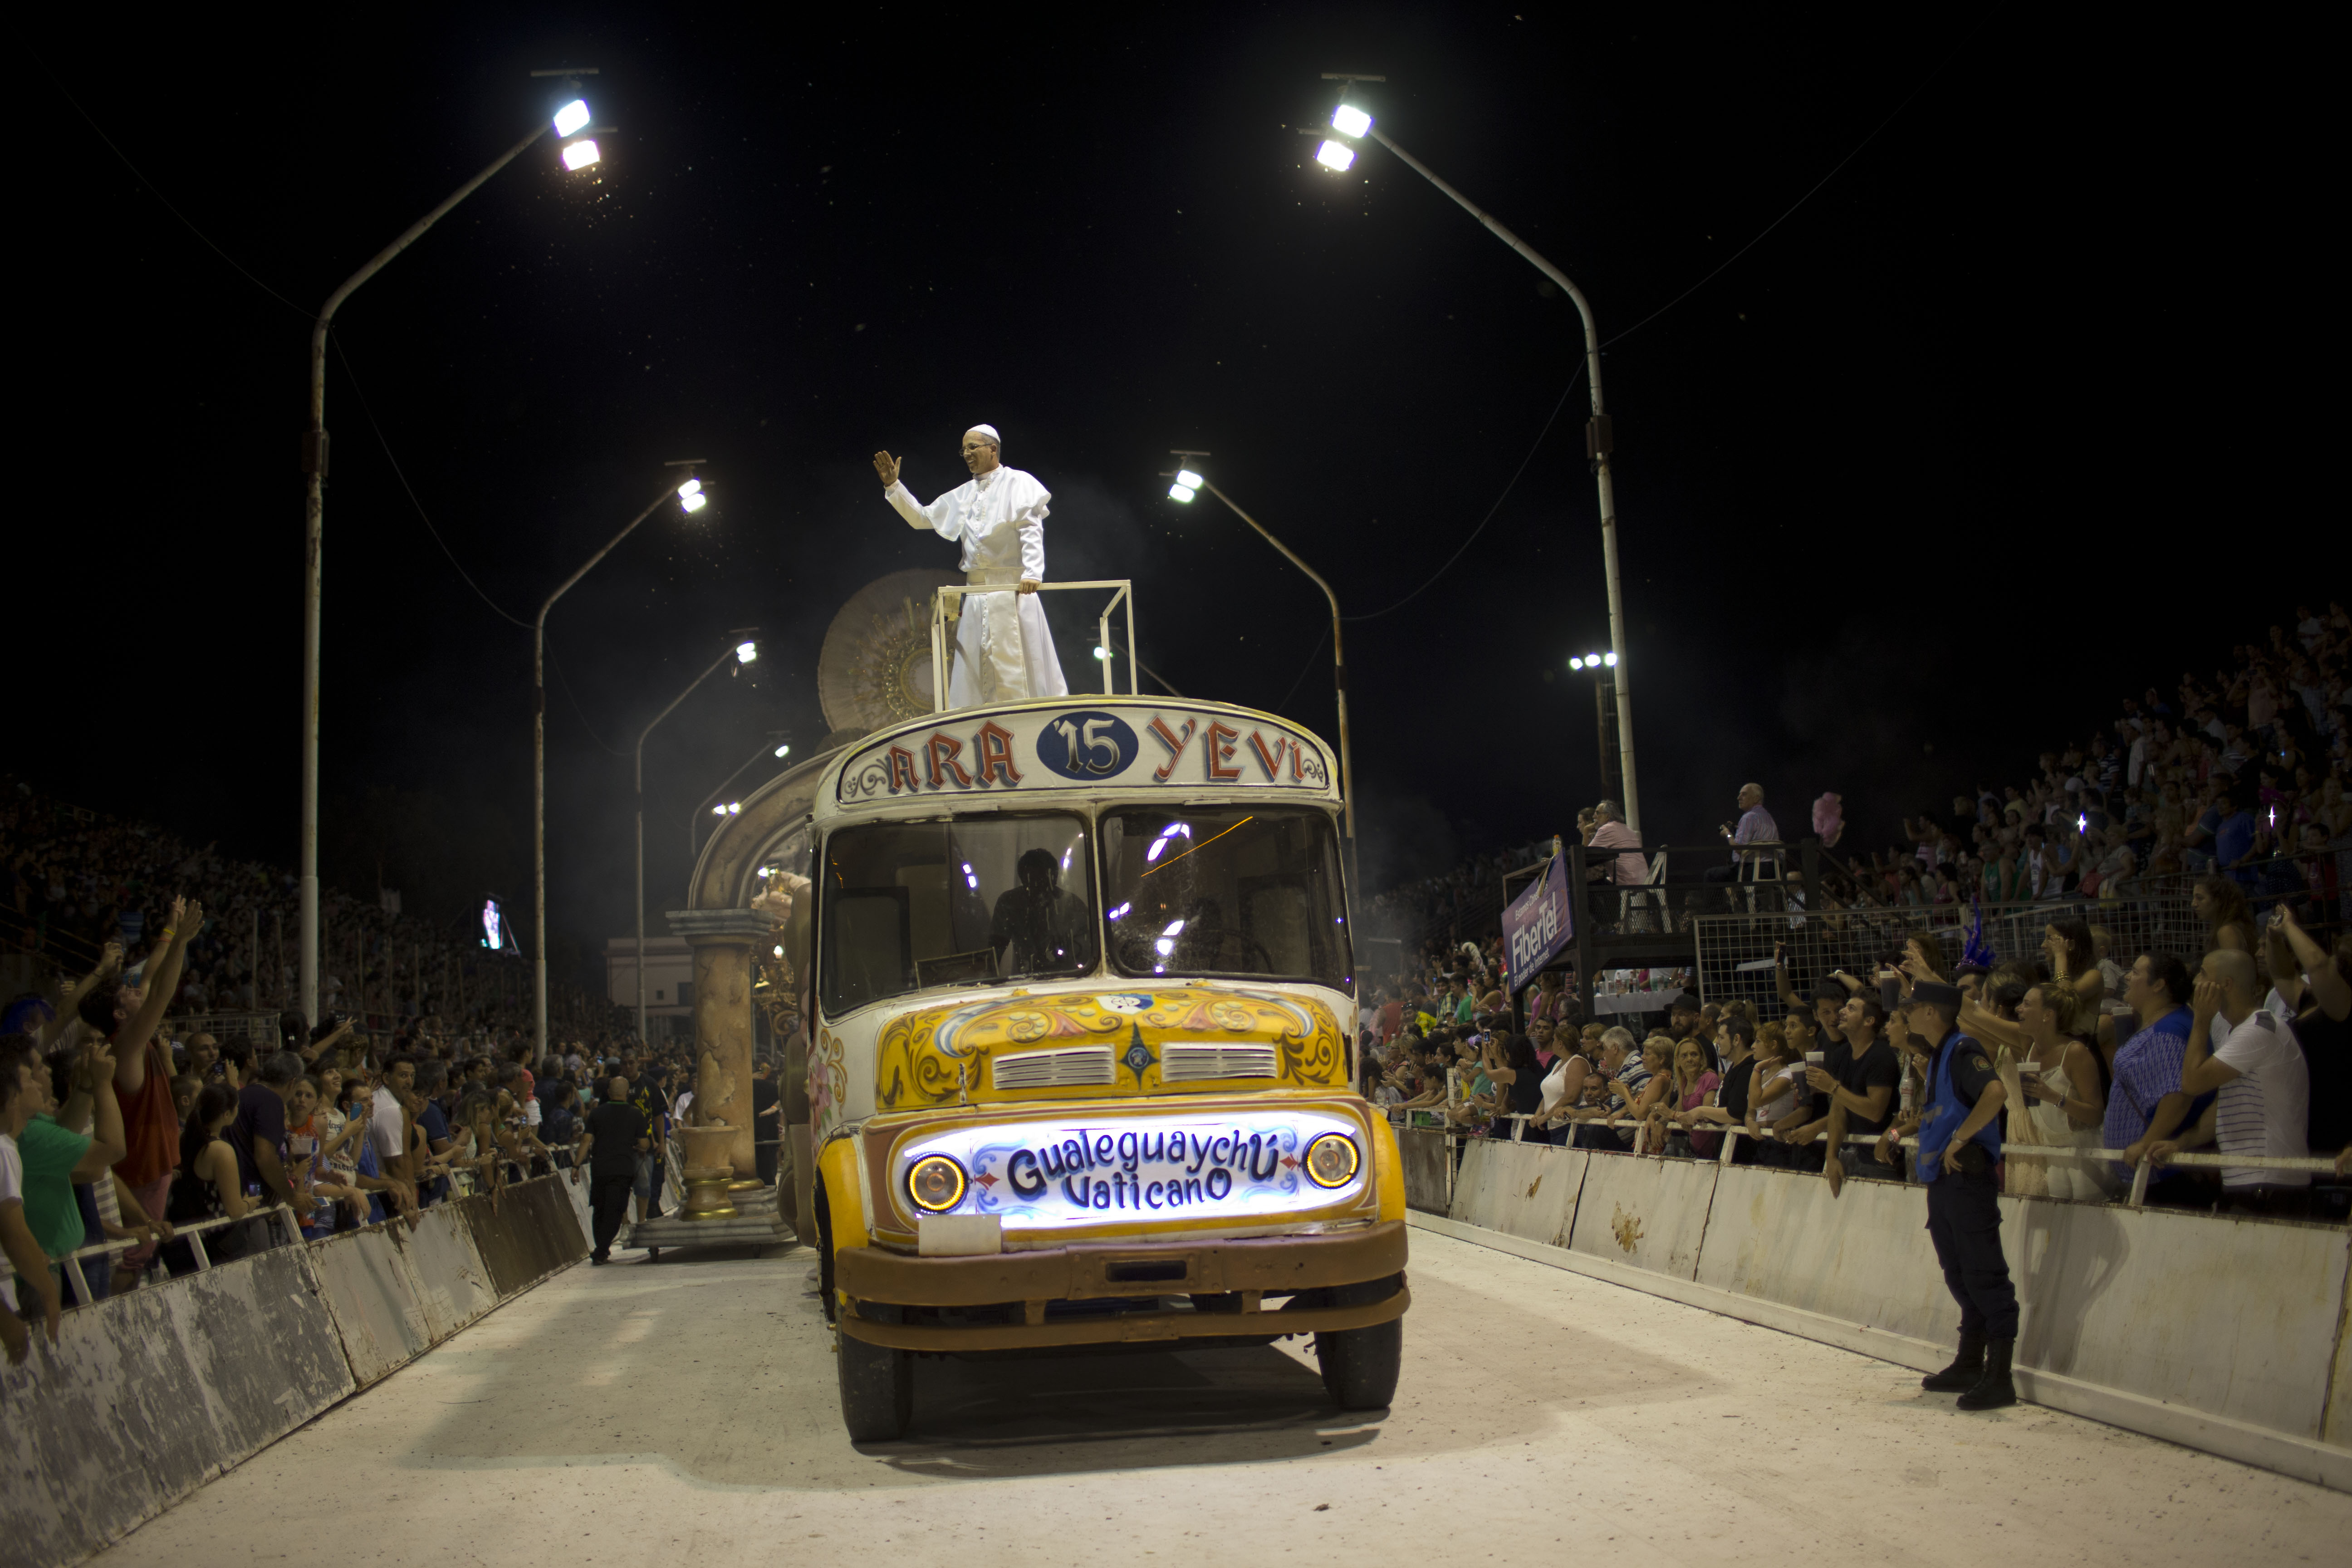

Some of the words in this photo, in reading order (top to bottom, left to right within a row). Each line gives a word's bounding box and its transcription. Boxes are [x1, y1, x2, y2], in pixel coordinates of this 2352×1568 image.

[887, 720, 1025, 792] ARA
[1512, 891, 1558, 974] FiberTel
[1516, 901, 1529, 921] Estamos
[1514, 974, 1518, 987] El
[1518, 967, 1529, 986] poder
[1529, 961, 1534, 974] de
[1534, 946, 1550, 969] Internet
